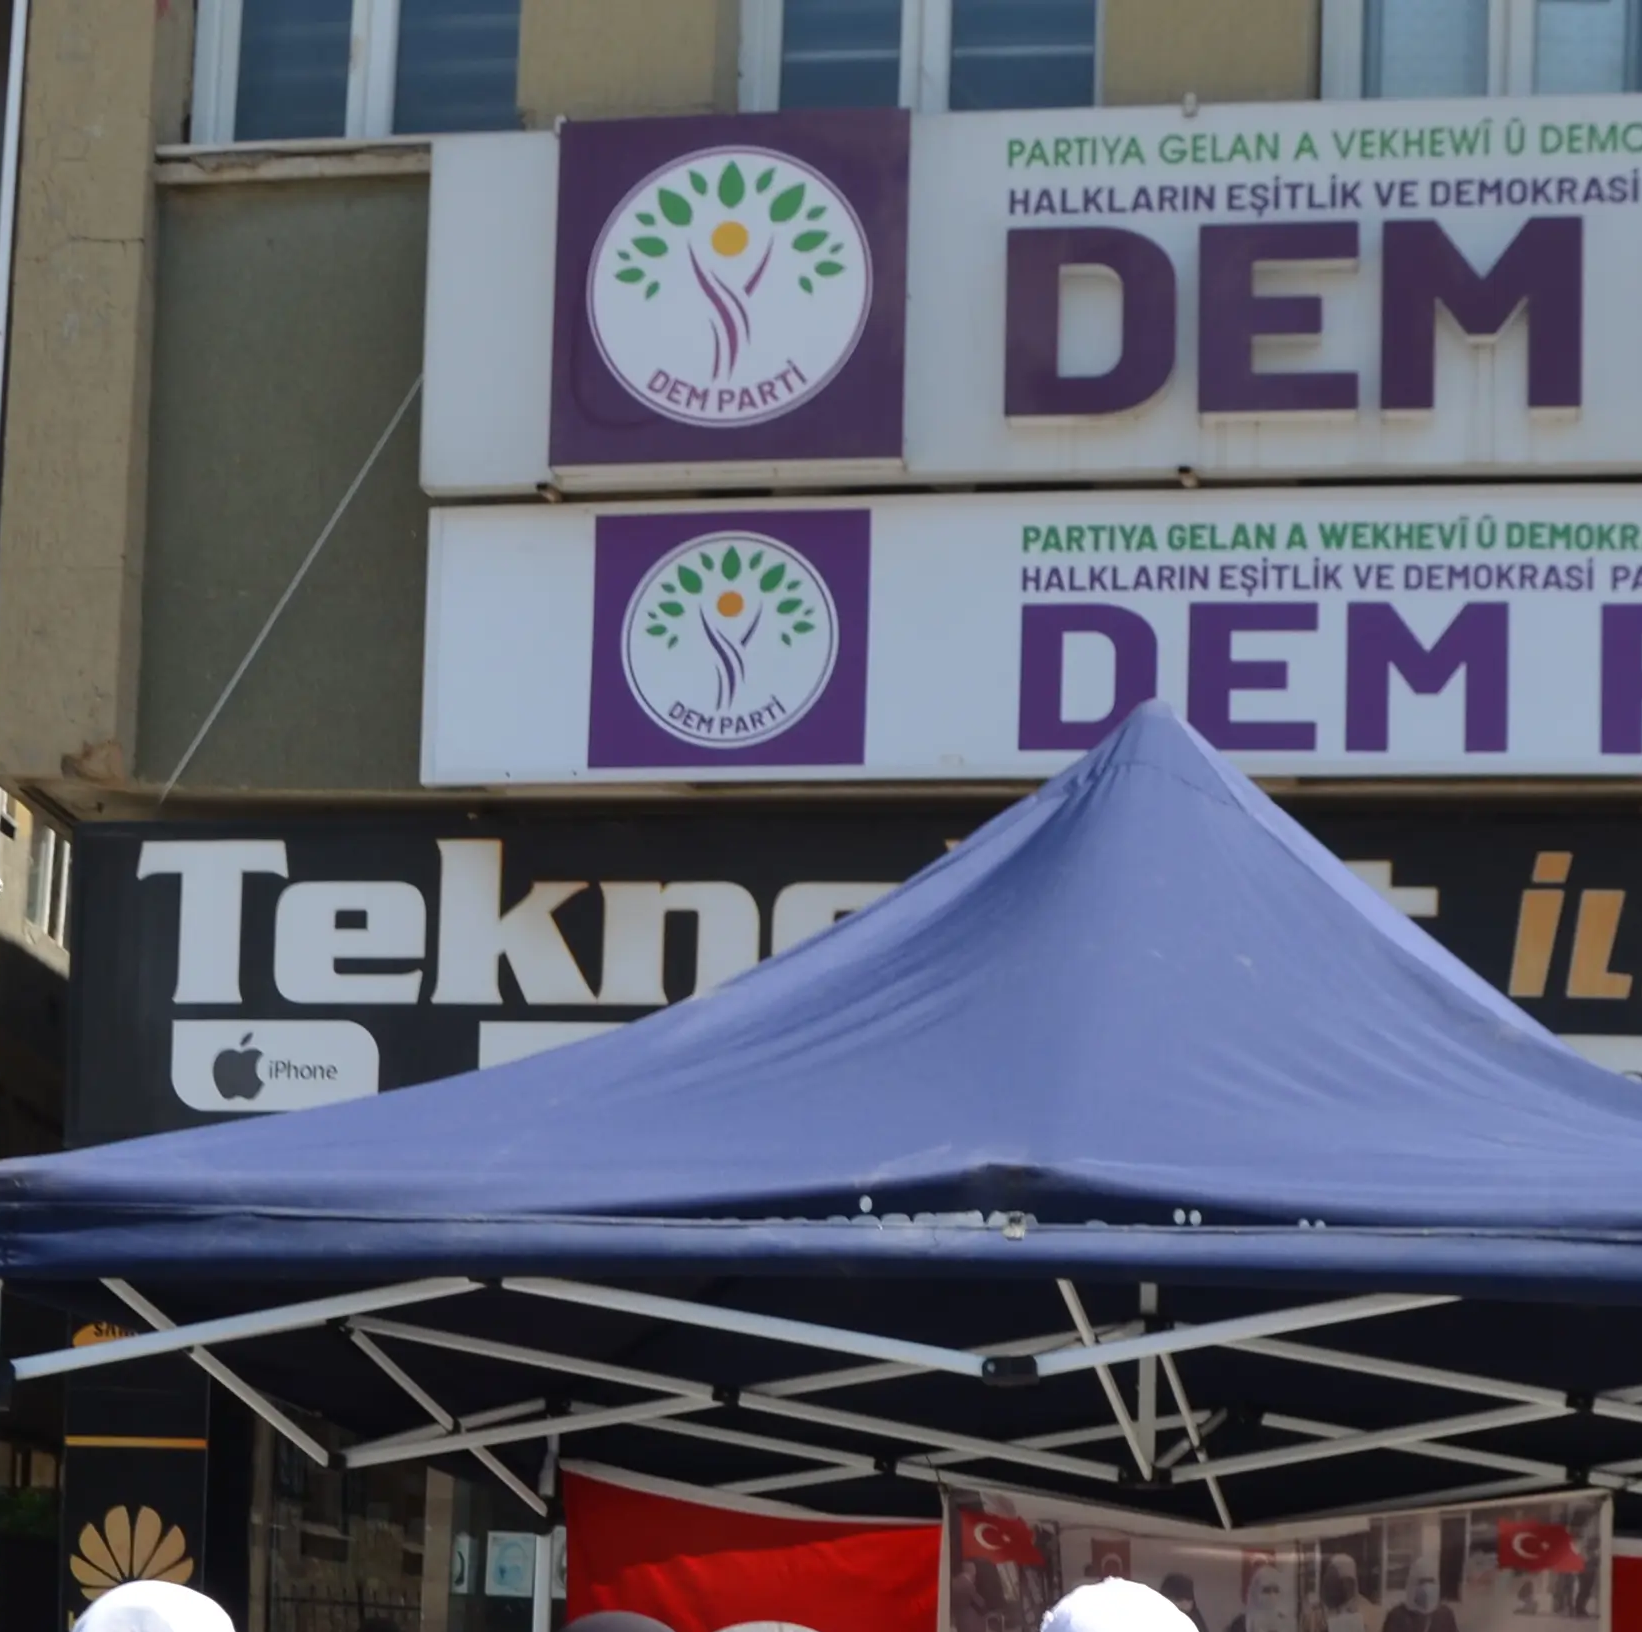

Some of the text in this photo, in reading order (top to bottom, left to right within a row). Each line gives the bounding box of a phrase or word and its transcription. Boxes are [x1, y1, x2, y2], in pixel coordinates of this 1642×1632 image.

[1007, 136, 1146, 168] PARTIYA
[1158, 131, 1280, 165] GELAN
[1293, 132, 1319, 161] A
[1333, 117, 1493, 160] VEKHEWÎ
[1505, 117, 1527, 155] Û
[1008, 183, 1216, 215] HALKLARIN
[1225, 175, 1362, 217] EŞİTLİK
[1374, 180, 1418, 208] VE
[1430, 168, 1639, 208] DEMOKRASİ
[1004, 217, 1583, 416] DEM
[646, 358, 808, 413] DEM PARTİ
[1021, 525, 1158, 552] PARTIYA
[1167, 523, 1277, 550] GELAN
[1285, 523, 1309, 549] A
[1318, 516, 1468, 550] WEKHEVÎ
[1475, 515, 1497, 549] Û
[1021, 565, 1210, 592] HALKLARIN
[1219, 557, 1343, 597] EŞİTLİK
[1353, 564, 1394, 590] VE
[1404, 557, 1594, 591] DEMOKRASİ
[1018, 601, 1508, 752] DEM
[668, 694, 787, 735] DEM PARTİ
[269, 1060, 339, 1081] iPhone
